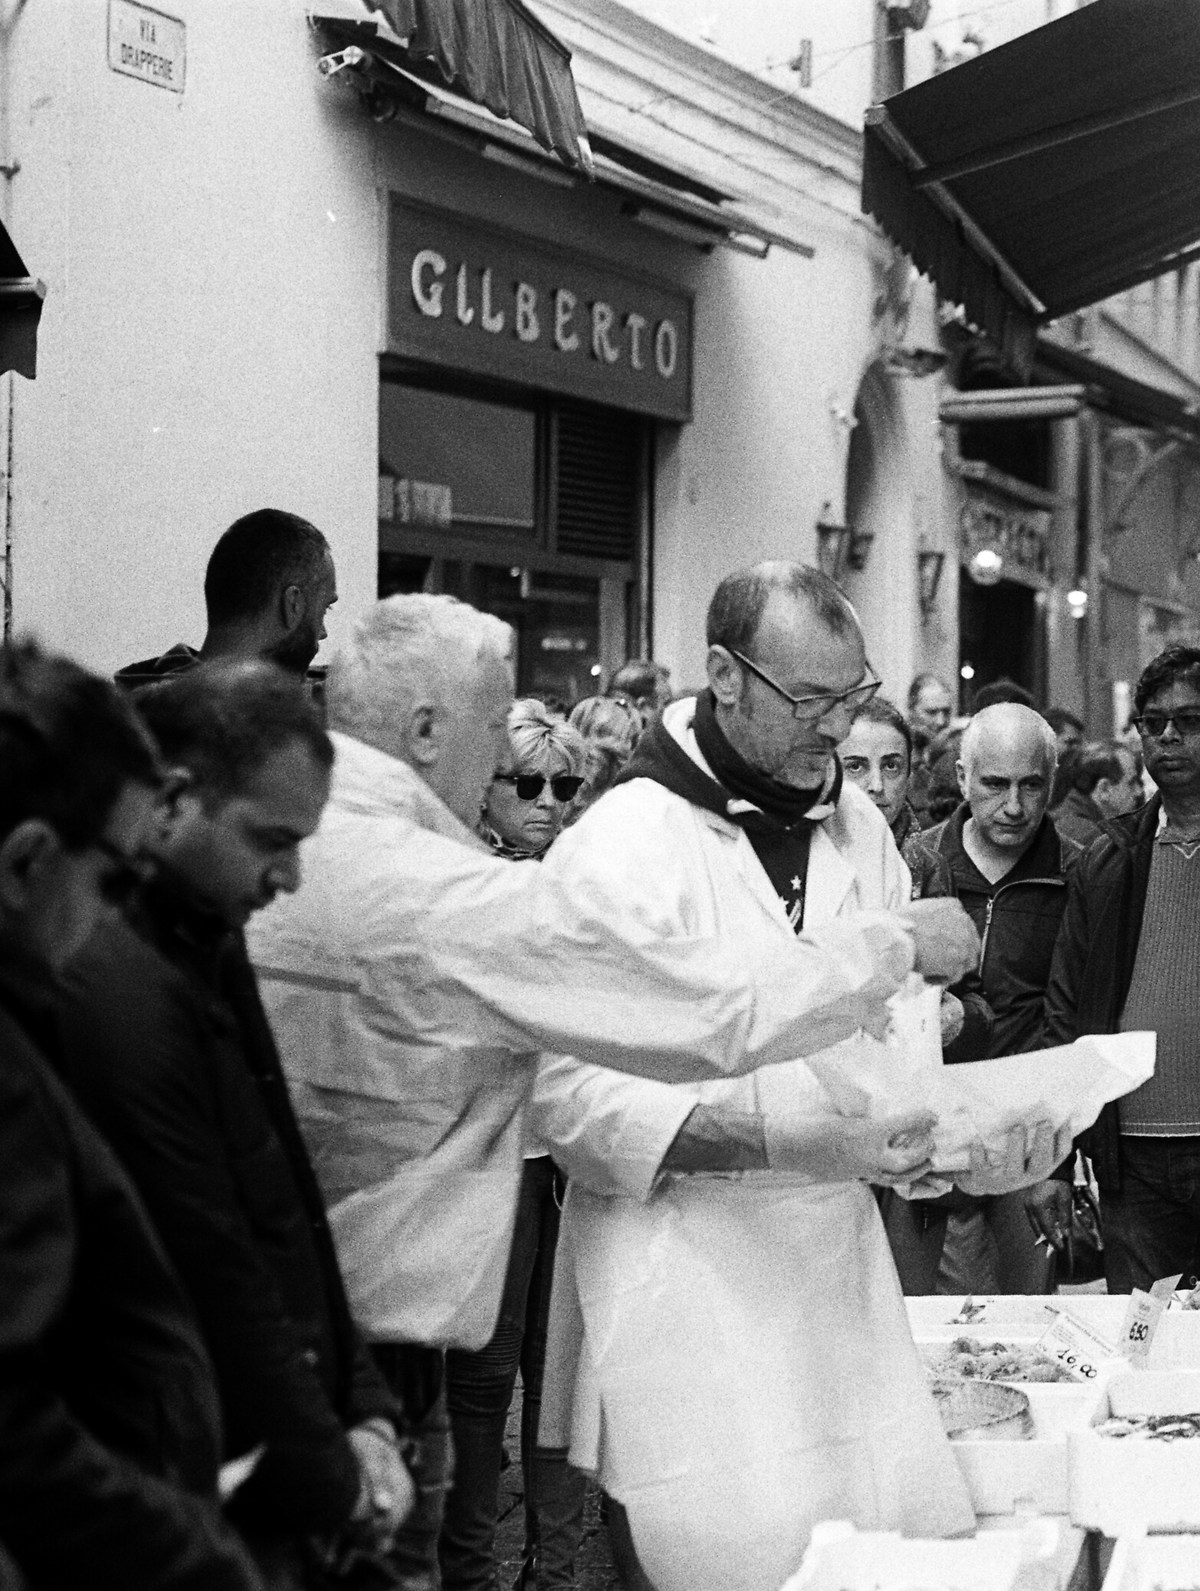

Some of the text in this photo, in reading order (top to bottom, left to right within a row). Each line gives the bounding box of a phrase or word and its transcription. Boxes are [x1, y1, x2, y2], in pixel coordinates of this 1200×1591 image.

[139, 19, 157, 42] VIA
[121, 42, 173, 80] DRAPPERIE
[410, 249, 678, 378] GILBERTO
